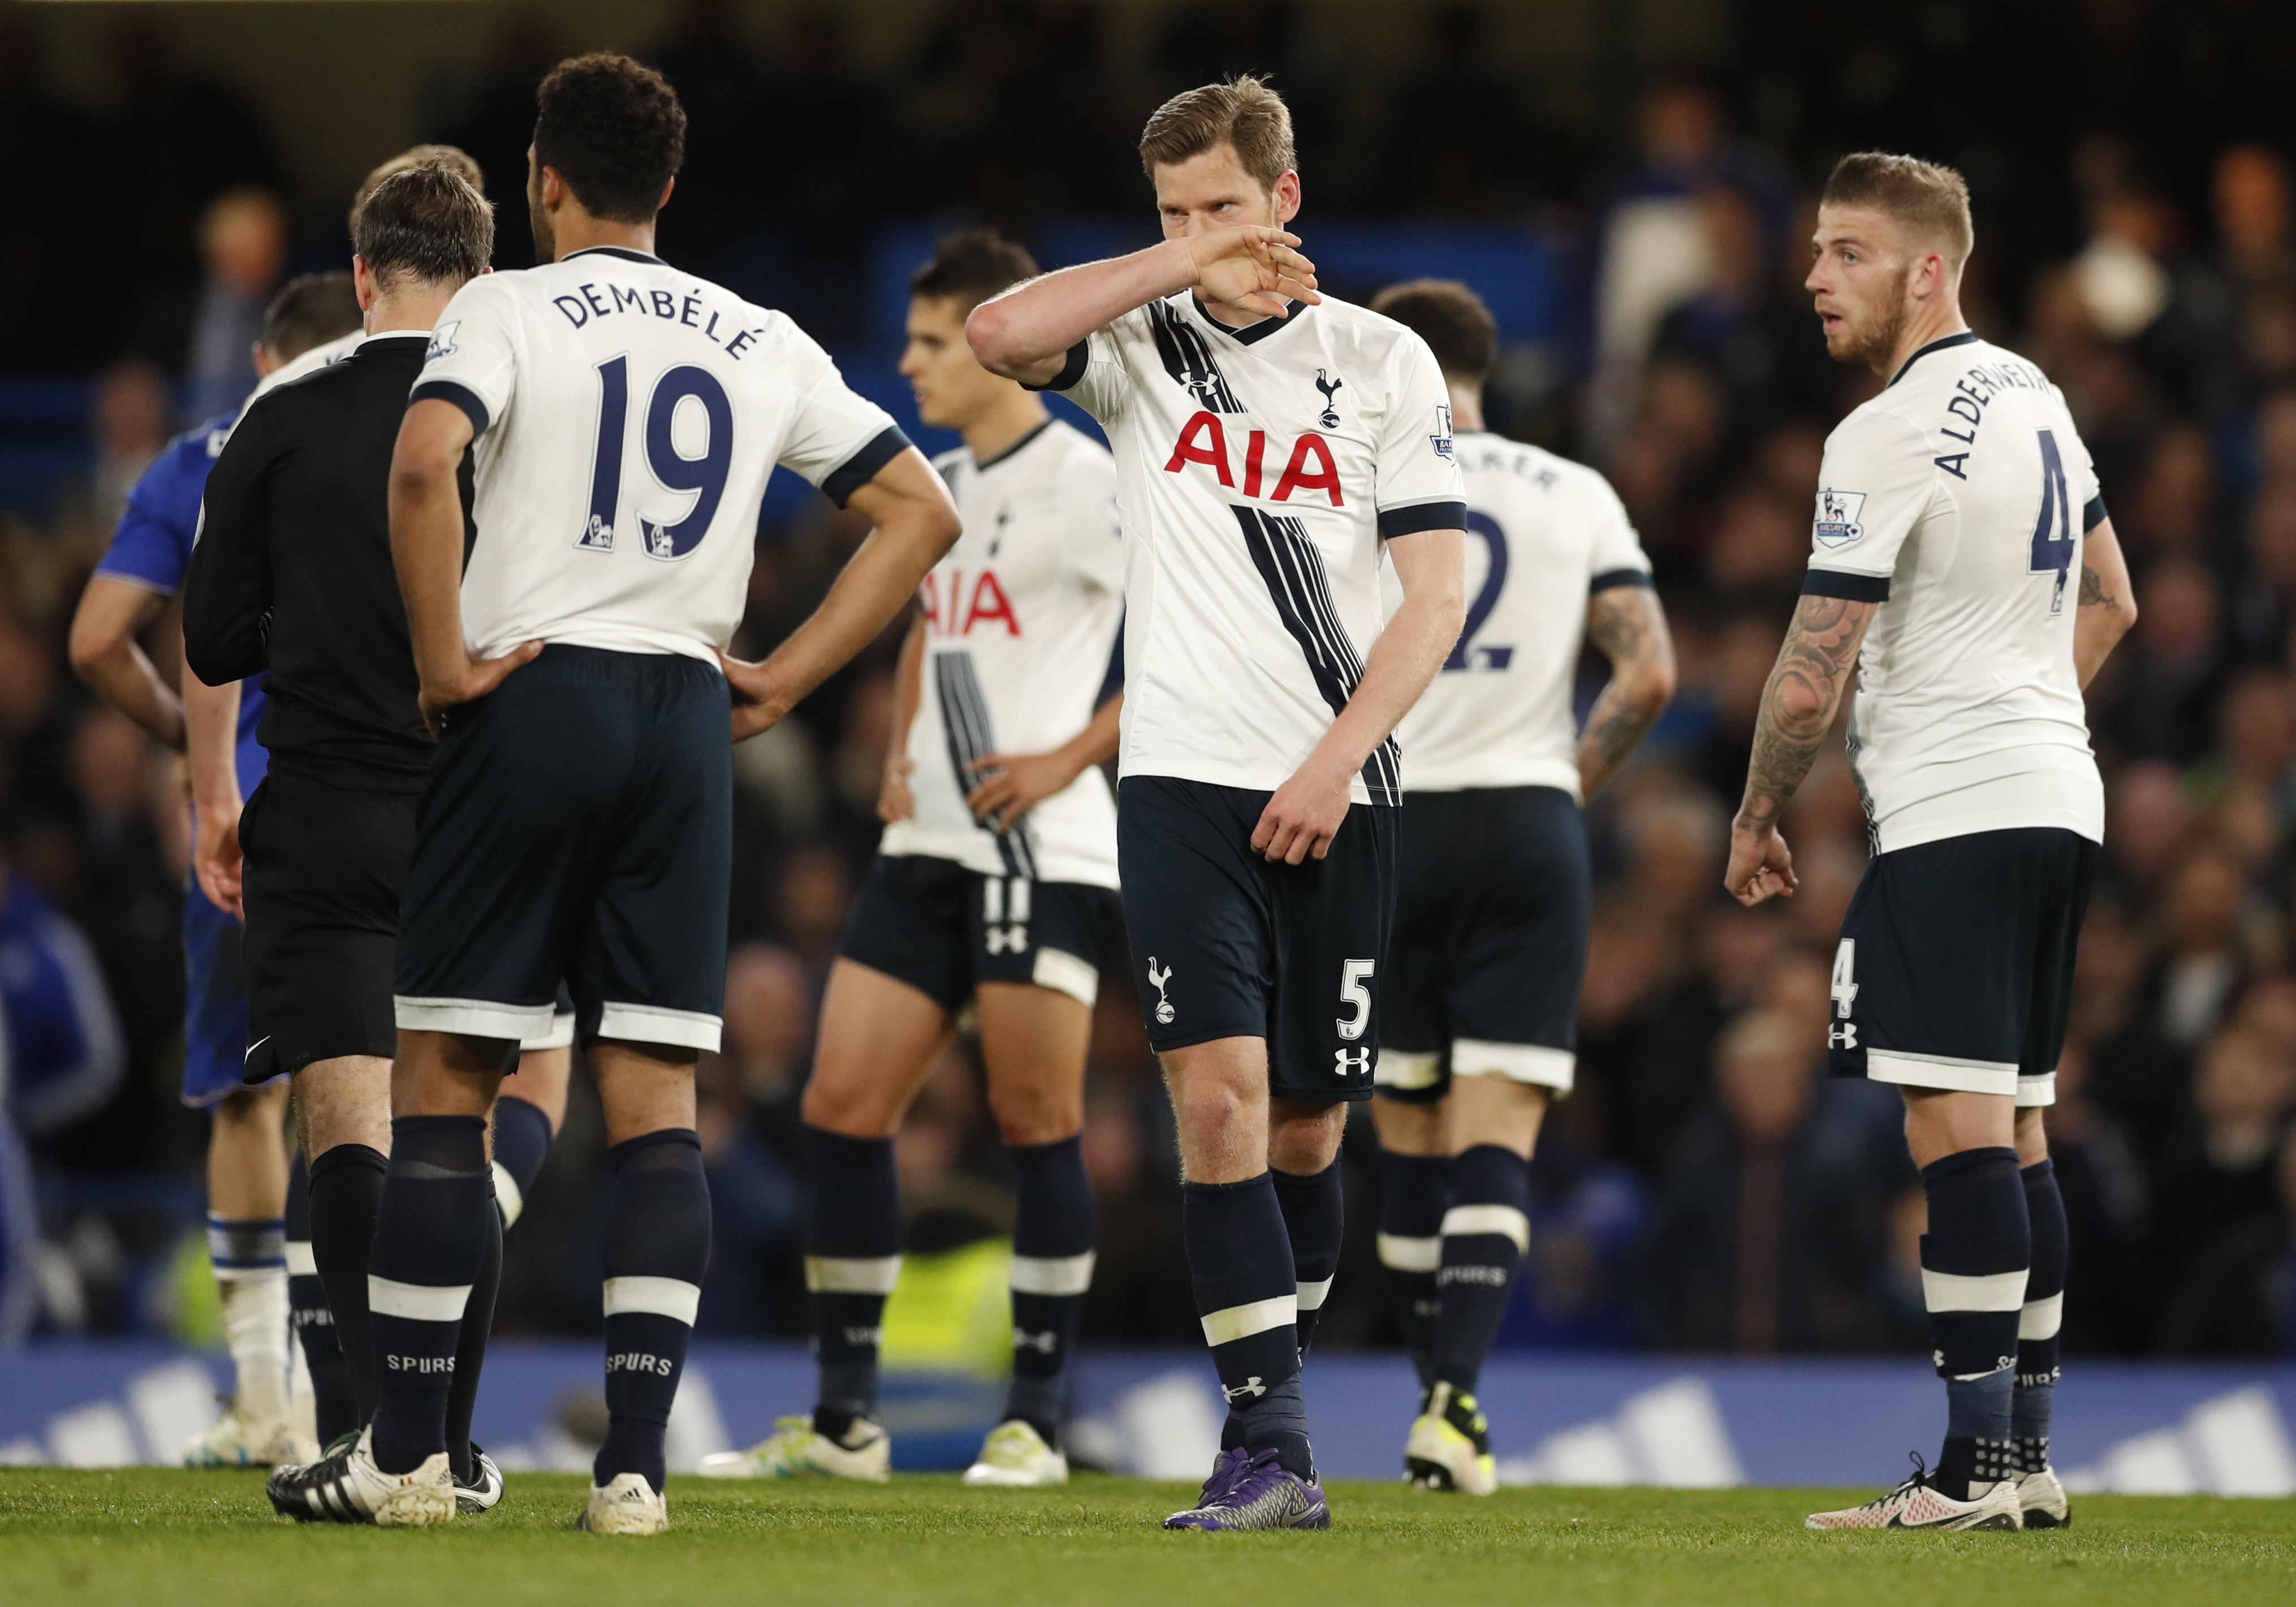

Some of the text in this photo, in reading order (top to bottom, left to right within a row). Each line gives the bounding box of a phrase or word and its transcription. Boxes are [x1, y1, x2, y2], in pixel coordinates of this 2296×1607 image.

[552, 283, 765, 360] DEMBÉLÉ
[573, 351, 736, 562] 19
[1164, 411, 1345, 507] AIA
[1934, 363, 2065, 481] ALDERWEIR
[2029, 428, 2077, 615] 4
[1439, 509, 1516, 672] 2
[983, 876, 1031, 923] 11
[1336, 959, 1375, 1040] 5
[1831, 938, 1859, 1018] 4
[387, 1354, 456, 1373] SPURS
[607, 1352, 672, 1376] SPURS
